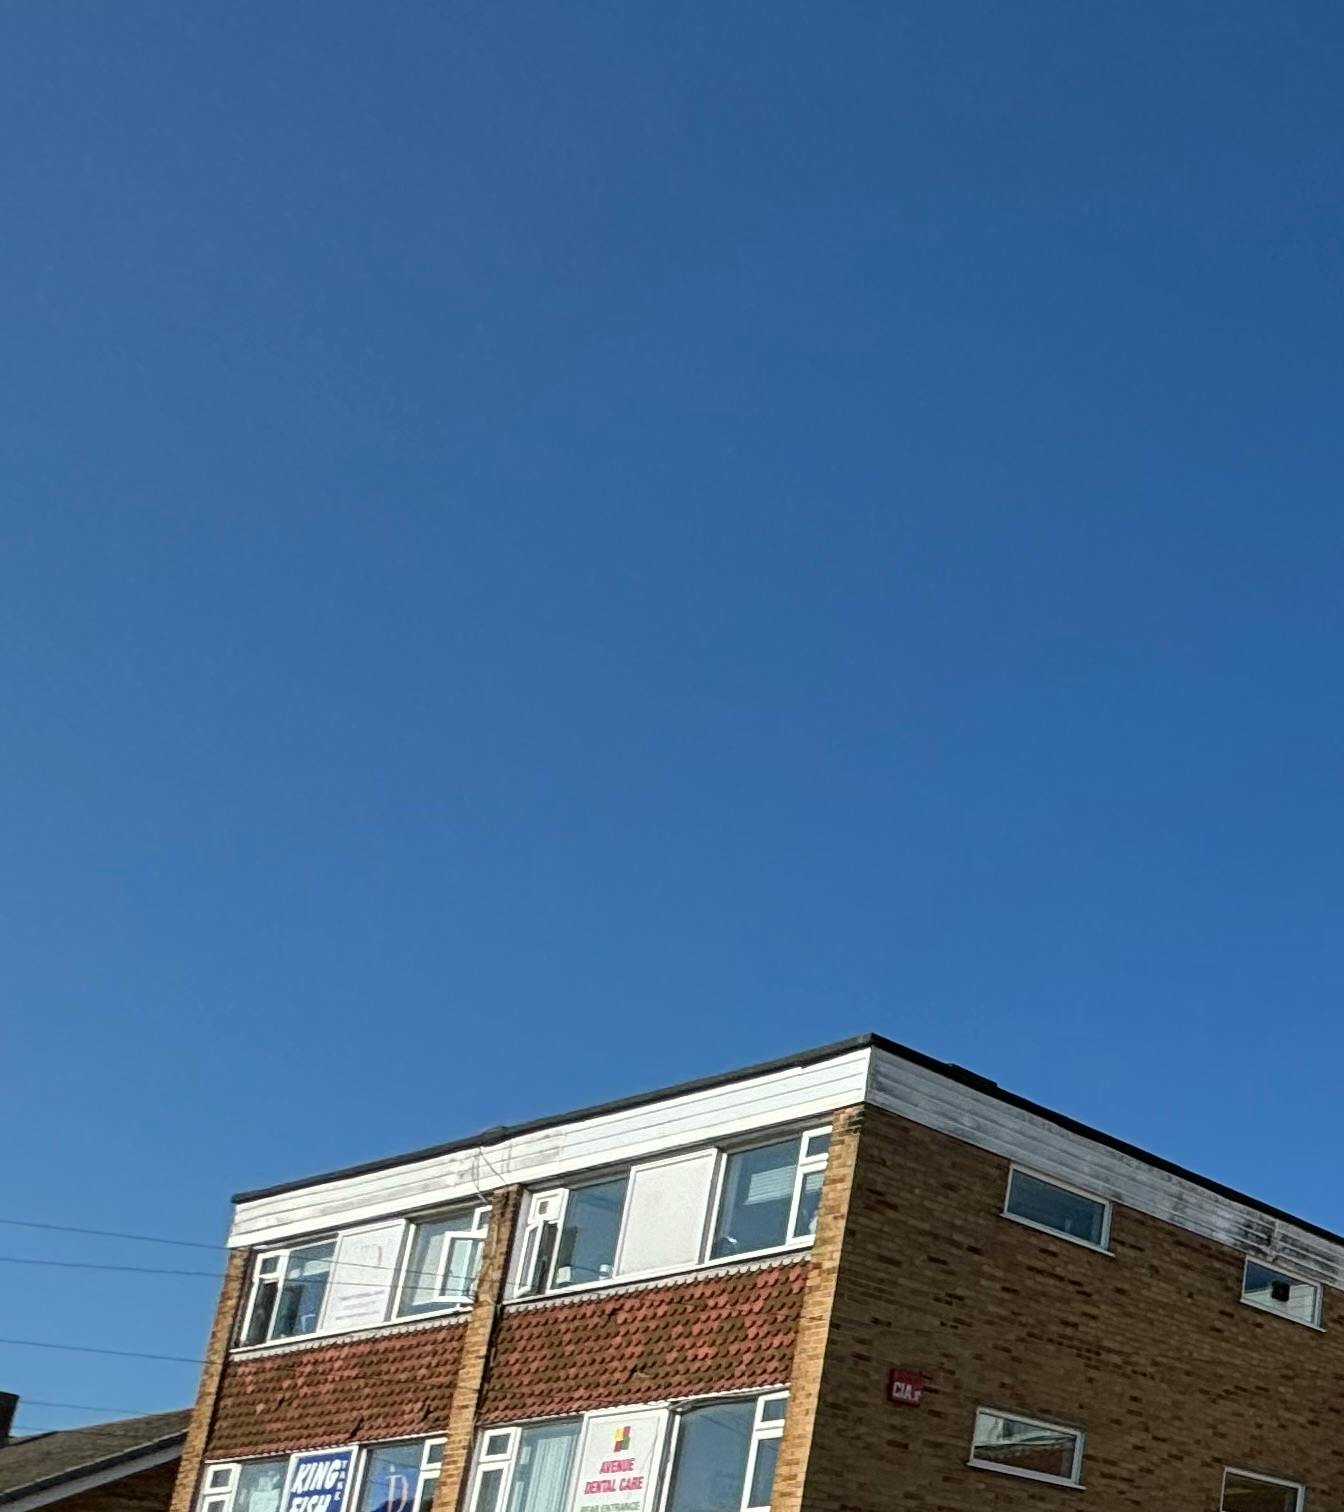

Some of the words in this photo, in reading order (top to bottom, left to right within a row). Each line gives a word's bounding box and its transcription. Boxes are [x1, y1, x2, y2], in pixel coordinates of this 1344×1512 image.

[290, 1459, 343, 1494] KING
[600, 1458, 635, 1475] AVENUE
[334, 1460, 349, 1501] TAKE
[584, 1479, 616, 1494] DENTAL
[619, 1476, 645, 1492] CARE
